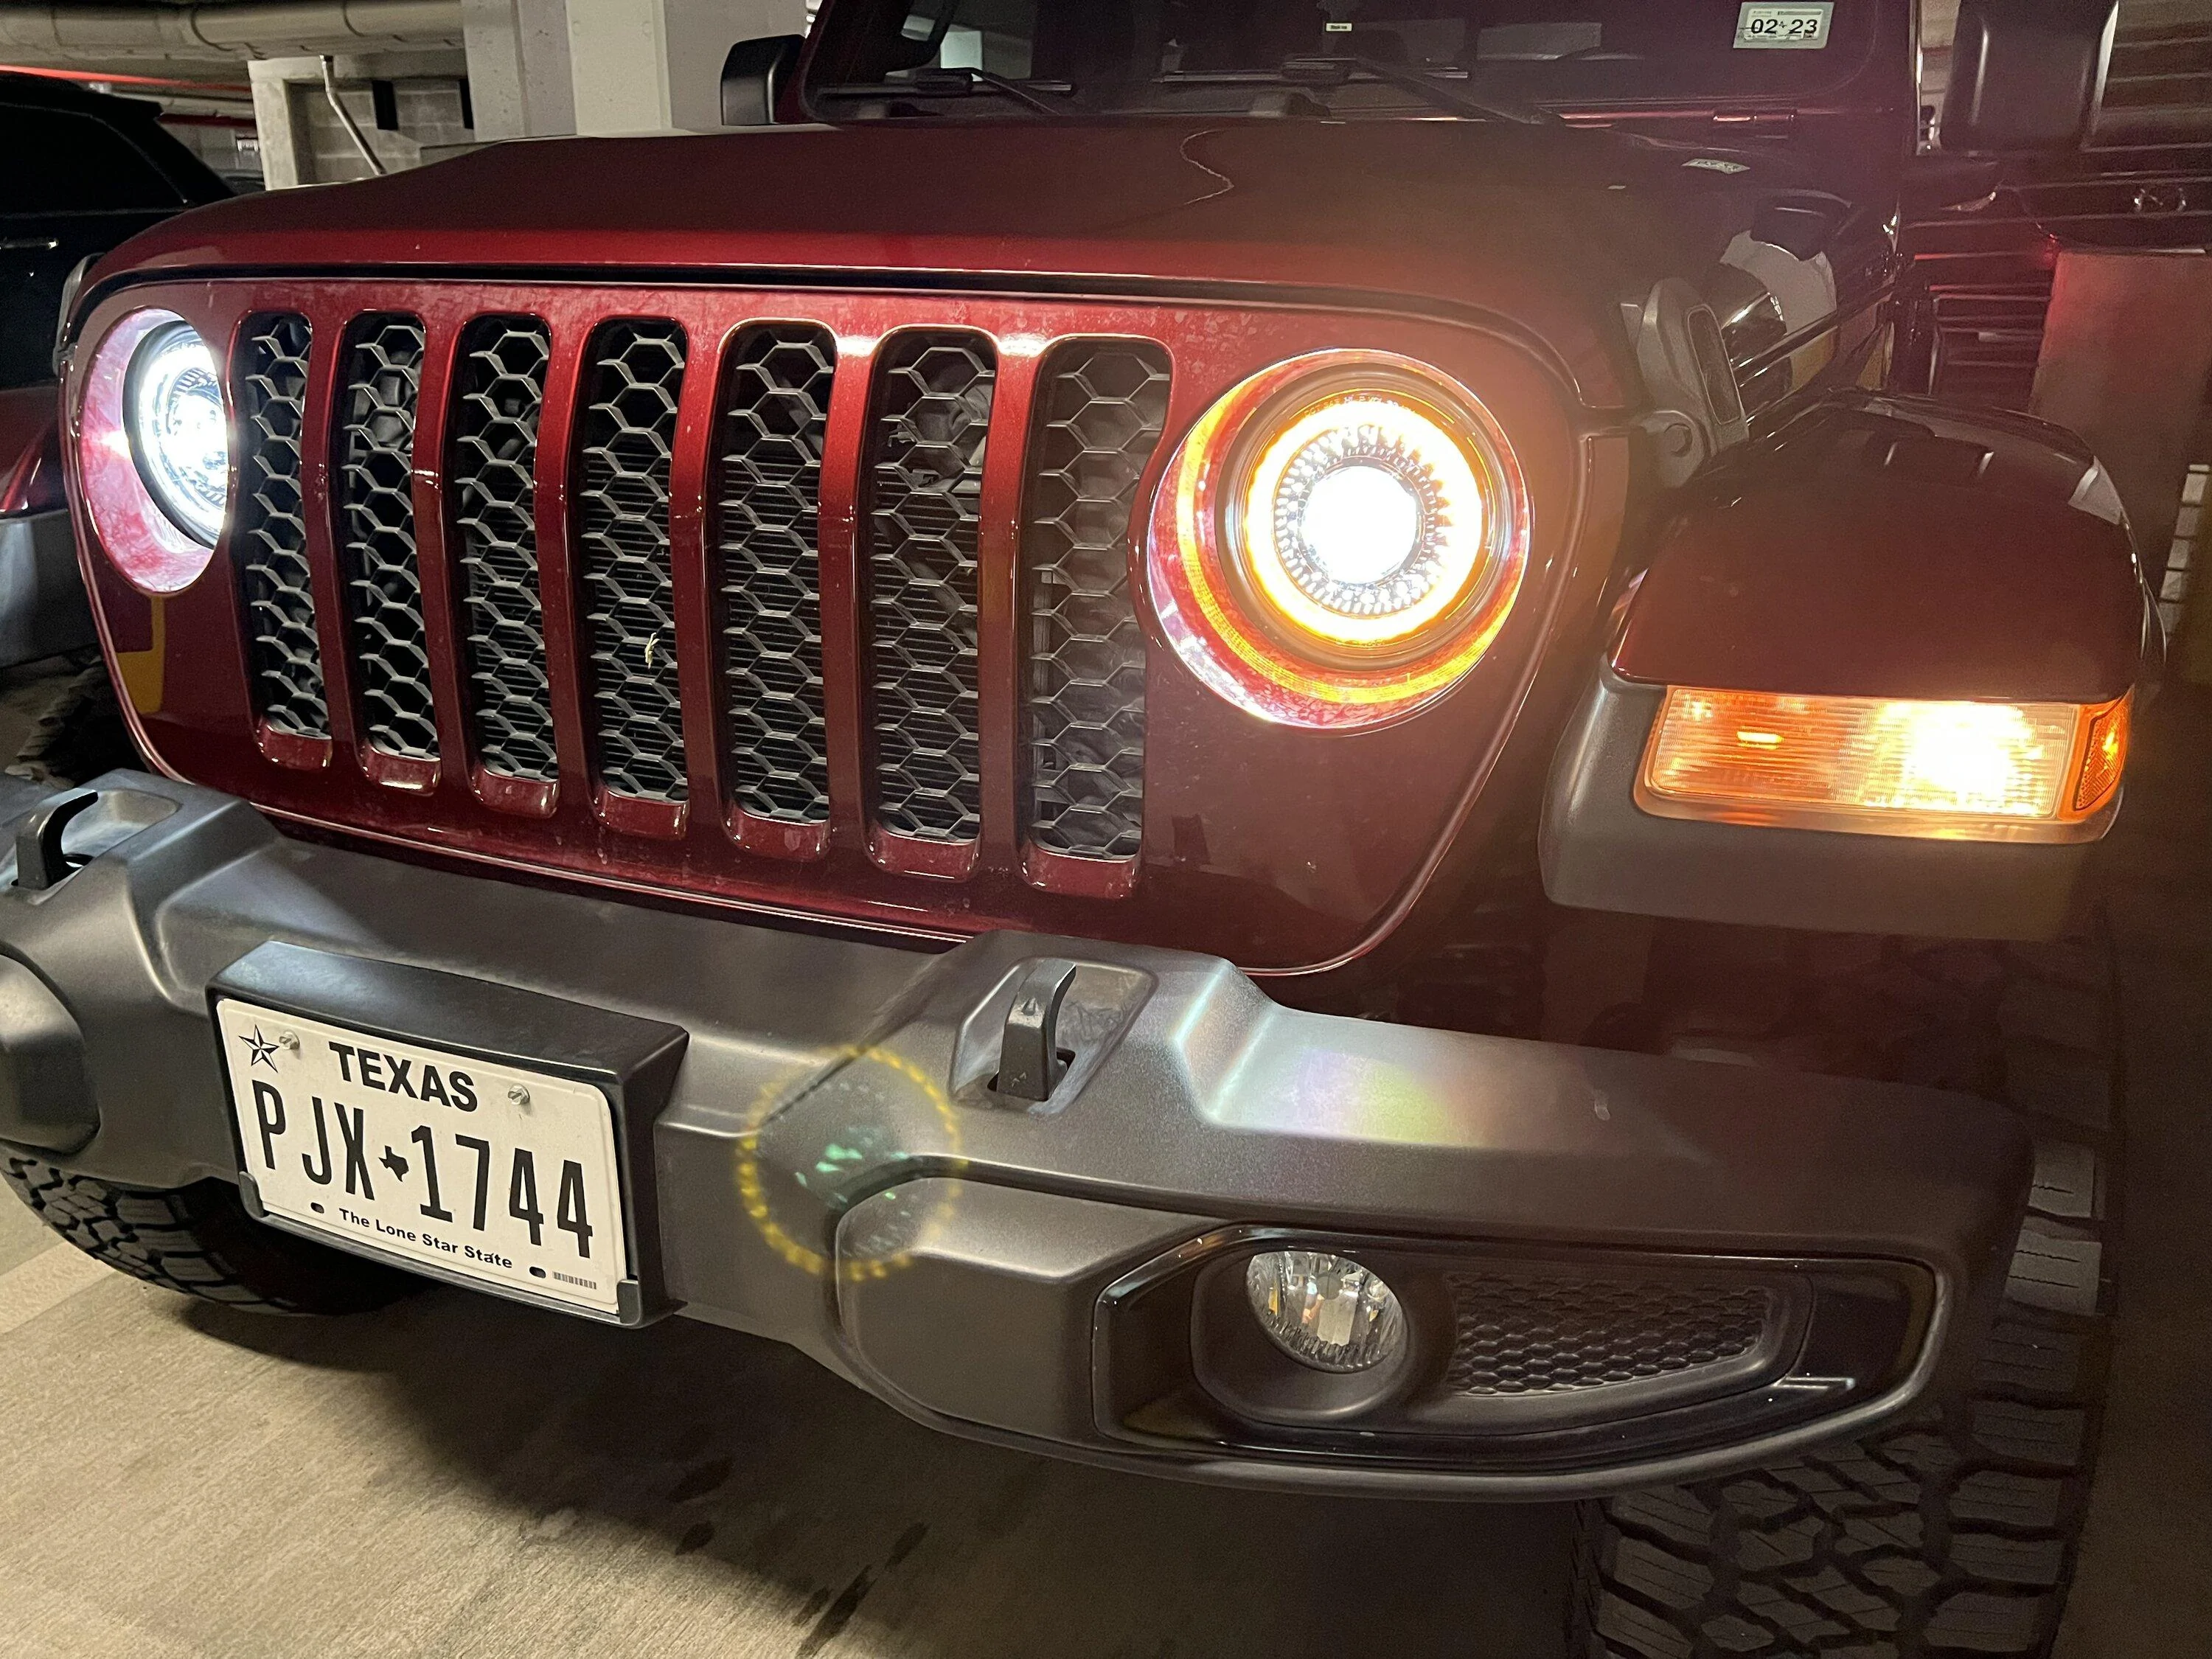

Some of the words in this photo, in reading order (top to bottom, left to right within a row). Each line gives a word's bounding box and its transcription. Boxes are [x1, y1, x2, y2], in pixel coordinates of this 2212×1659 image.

[1750, 18, 1778, 35] 02
[1788, 18, 1818, 35] 23
[327, 1041, 479, 1112] TEXAS
[251, 1079, 375, 1201] PJX
[411, 1124, 594, 1259] 1744
[338, 1207, 370, 1228] The
[375, 1219, 417, 1242] Lone
[422, 1233, 459, 1254] Star
[464, 1245, 513, 1269] State
